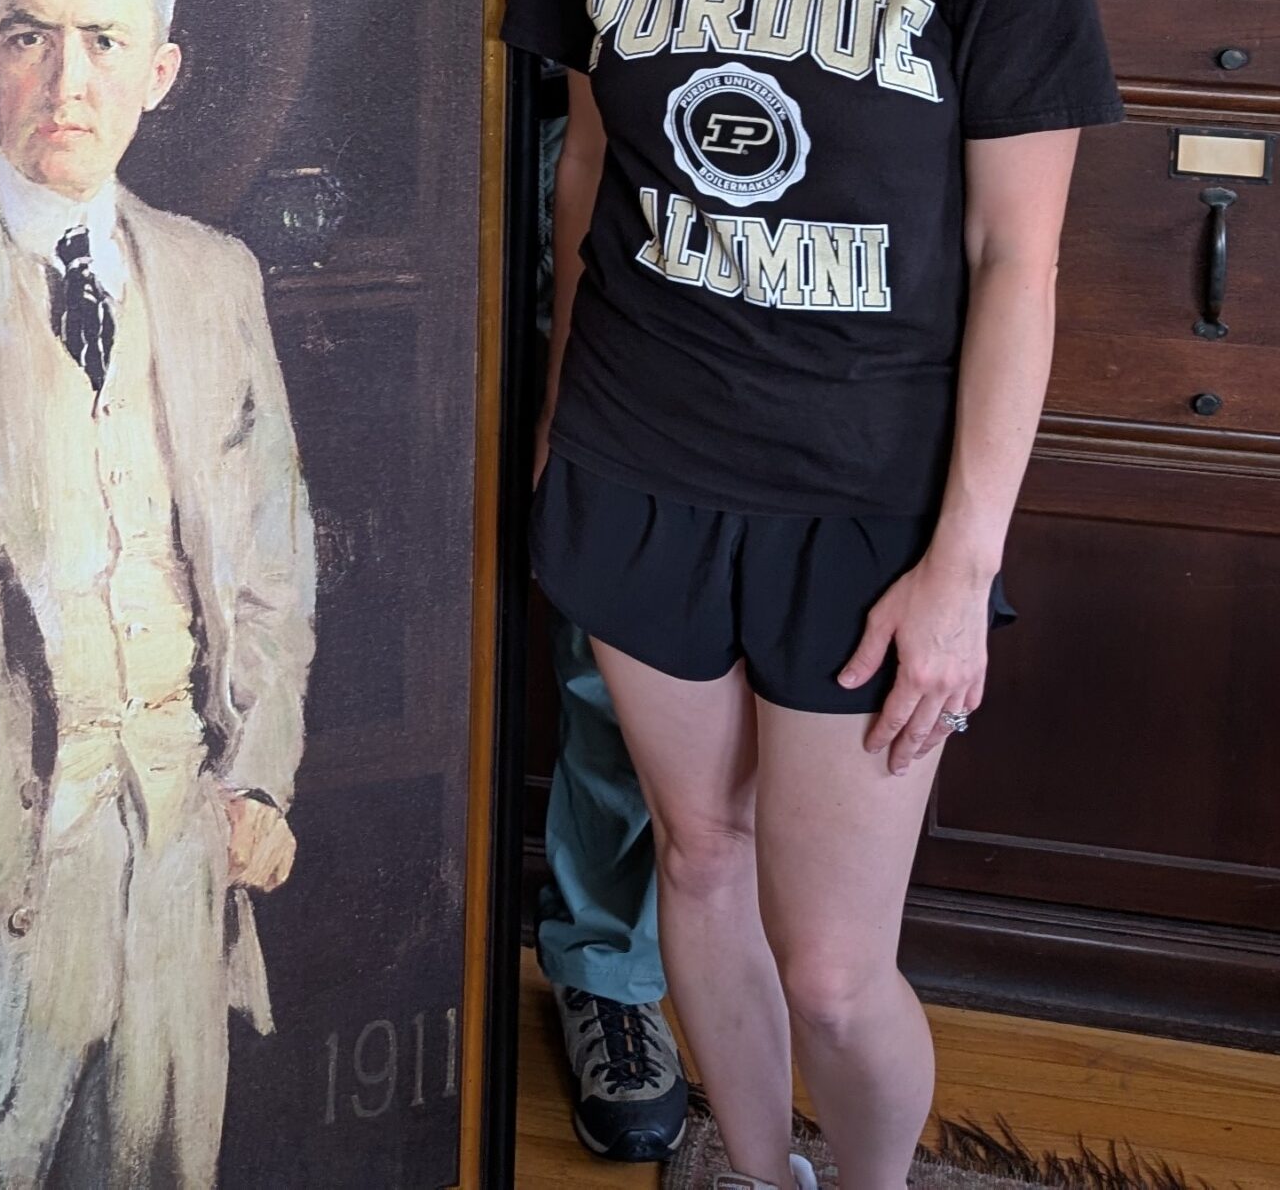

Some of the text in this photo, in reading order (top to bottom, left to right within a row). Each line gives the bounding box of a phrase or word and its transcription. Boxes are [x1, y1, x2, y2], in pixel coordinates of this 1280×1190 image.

[680, 76, 785, 116] PURDUE UNIVERSITY
[701, 113, 773, 154] P
[698, 166, 783, 192] BOILERMAKERS
[324, 1007, 458, 1125] 1911
